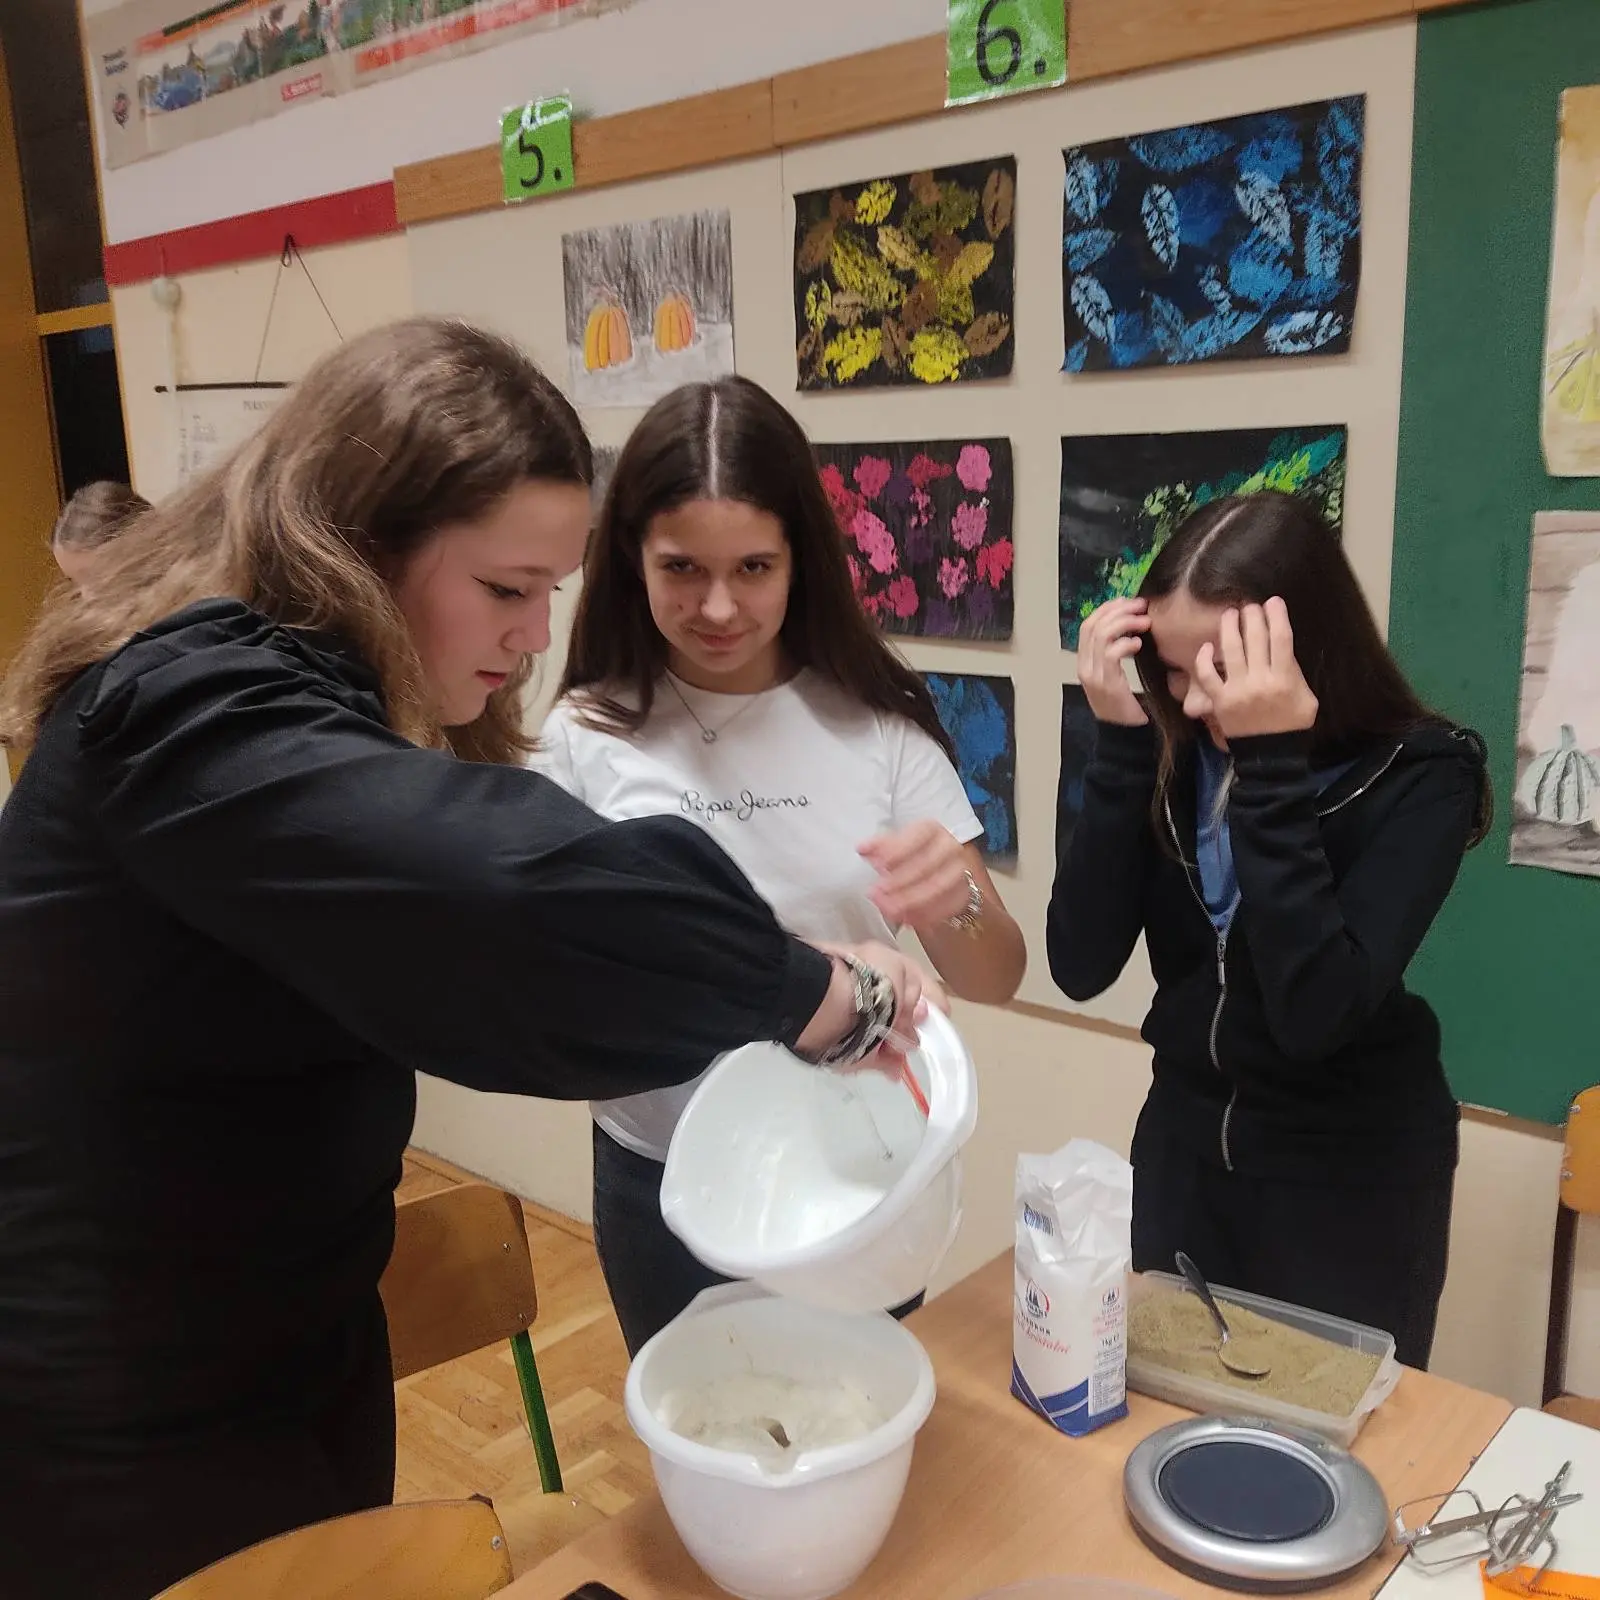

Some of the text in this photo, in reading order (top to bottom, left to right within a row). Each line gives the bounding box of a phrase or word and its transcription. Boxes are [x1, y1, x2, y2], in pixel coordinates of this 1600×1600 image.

[976, 0, 1047, 86] 6.
[518, 117, 563, 188] 5.
[680, 788, 809, 822] Pepe Jeans
